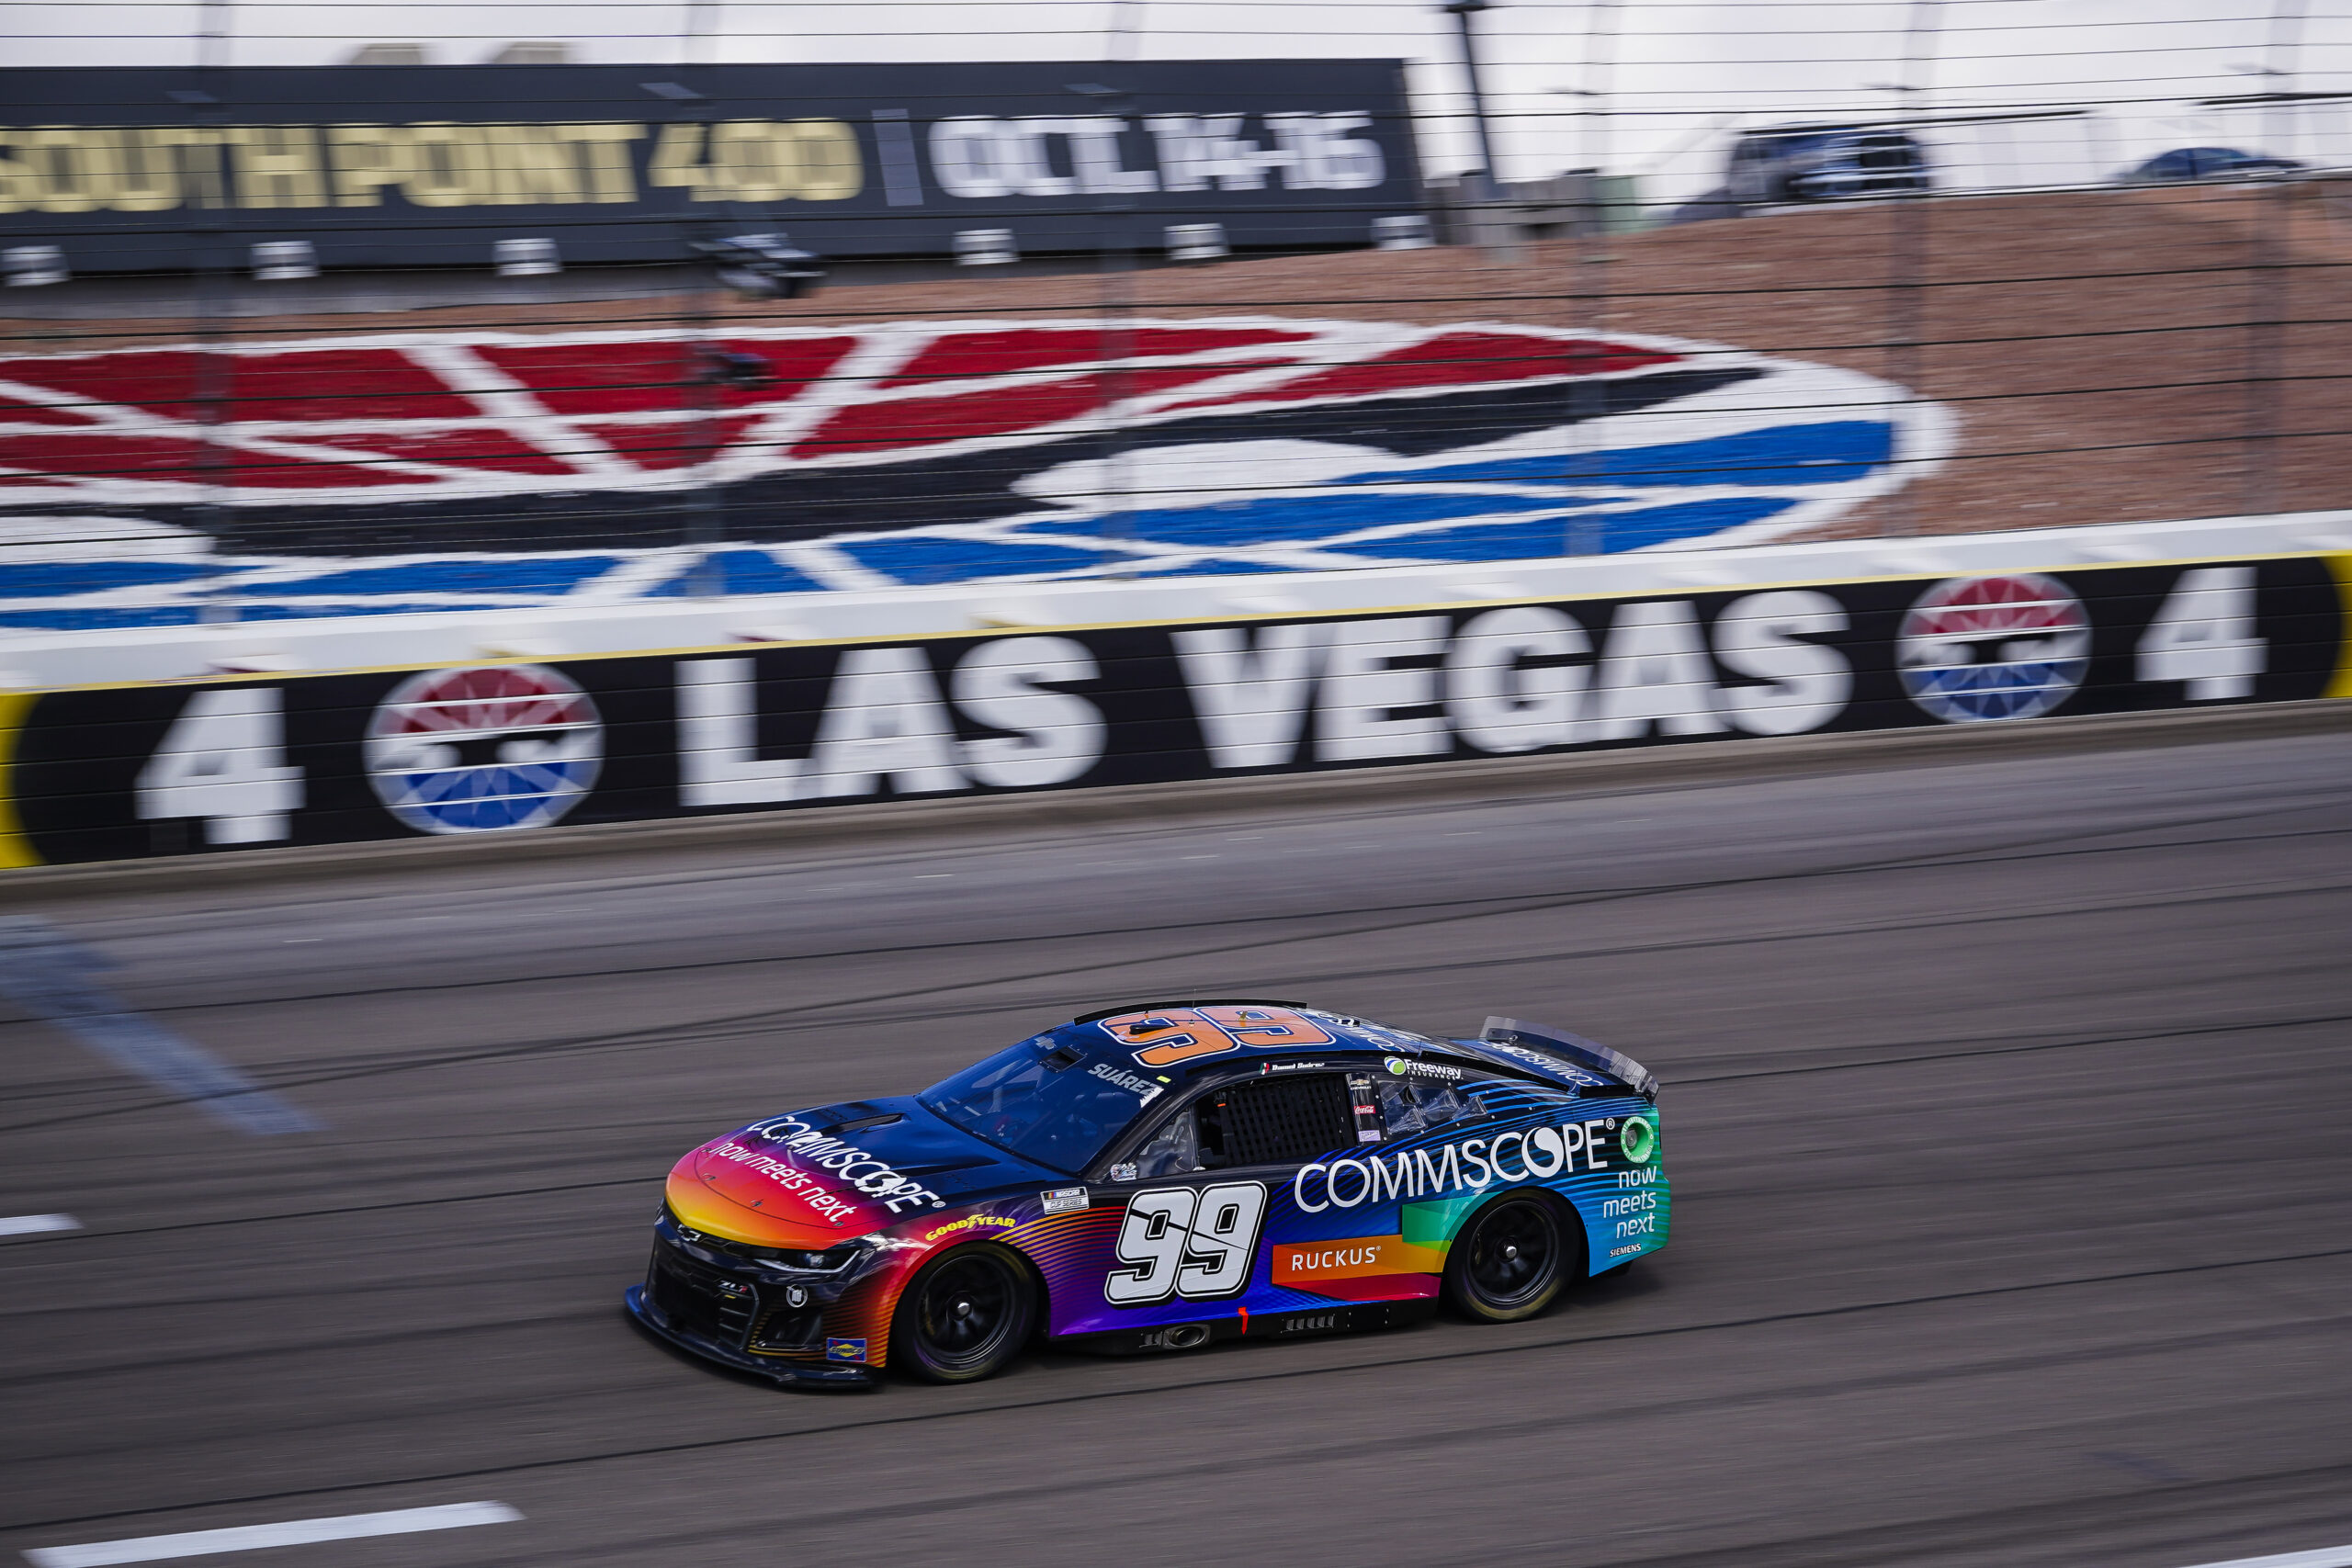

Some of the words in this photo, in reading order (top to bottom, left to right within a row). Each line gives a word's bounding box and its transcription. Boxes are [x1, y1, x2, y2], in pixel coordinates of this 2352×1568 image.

[322, 120, 649, 208] POINT
[647, 118, 865, 202] 400
[134, 687, 305, 844] 4
[674, 636, 1108, 807] LAS
[1168, 590, 1854, 769] VEGAS
[2134, 567, 2269, 700] 4
[1087, 1062, 1160, 1095] SUÁREZ
[1404, 1058, 1462, 1079] Freeway
[708, 1142, 756, 1162] now
[744, 1156, 812, 1190] meets
[797, 1186, 857, 1223] next
[1619, 1166, 1657, 1190] now
[1603, 1190, 1657, 1218] meets
[925, 1213, 1016, 1241] GOODYEAR
[1616, 1213, 1656, 1238] next
[1104, 1180, 1268, 1305] 99
[1610, 1243, 1642, 1258] SIEMENS
